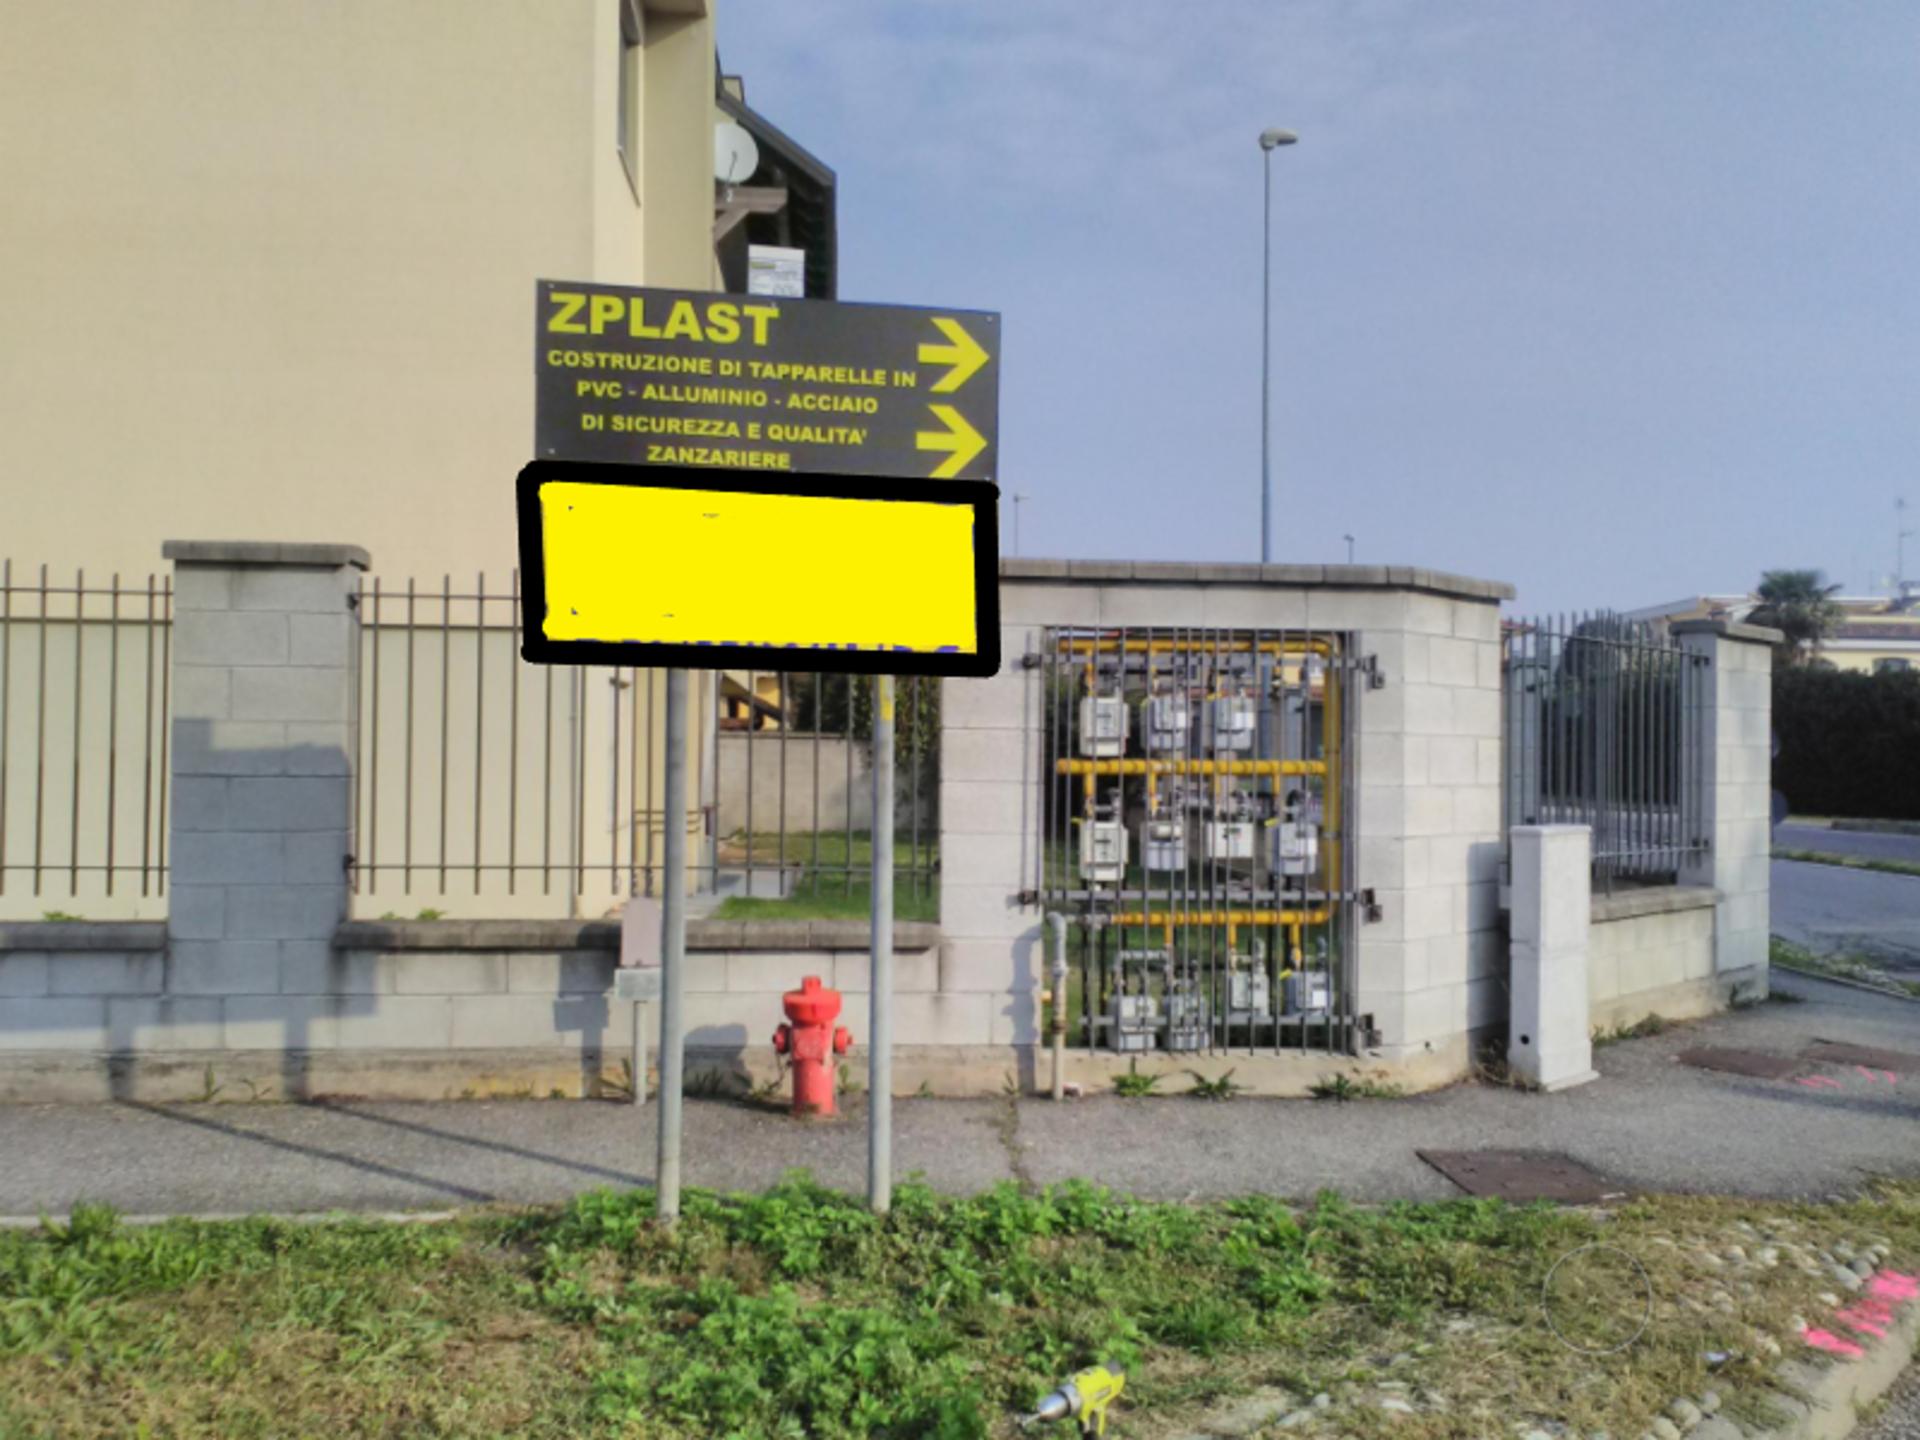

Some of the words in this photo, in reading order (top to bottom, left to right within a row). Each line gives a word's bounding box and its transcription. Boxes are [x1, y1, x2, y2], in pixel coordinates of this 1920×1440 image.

[548, 292, 779, 346] ZPLAST
[547, 349, 713, 375] COSTRUZIONE
[718, 359, 742, 377] DI
[748, 360, 887, 386] TAPPARELLE
[893, 370, 916, 388] IN
[576, 379, 622, 399] PVC
[641, 383, 767, 407] ALLUMINIO
[787, 392, 878, 415] ACCIAIO
[581, 413, 605, 431] DI
[610, 414, 741, 438] SICUREZZA
[747, 422, 761, 440] E
[766, 423, 867, 445] QUALITA'
[647, 444, 791, 469] ZANZARIERE
